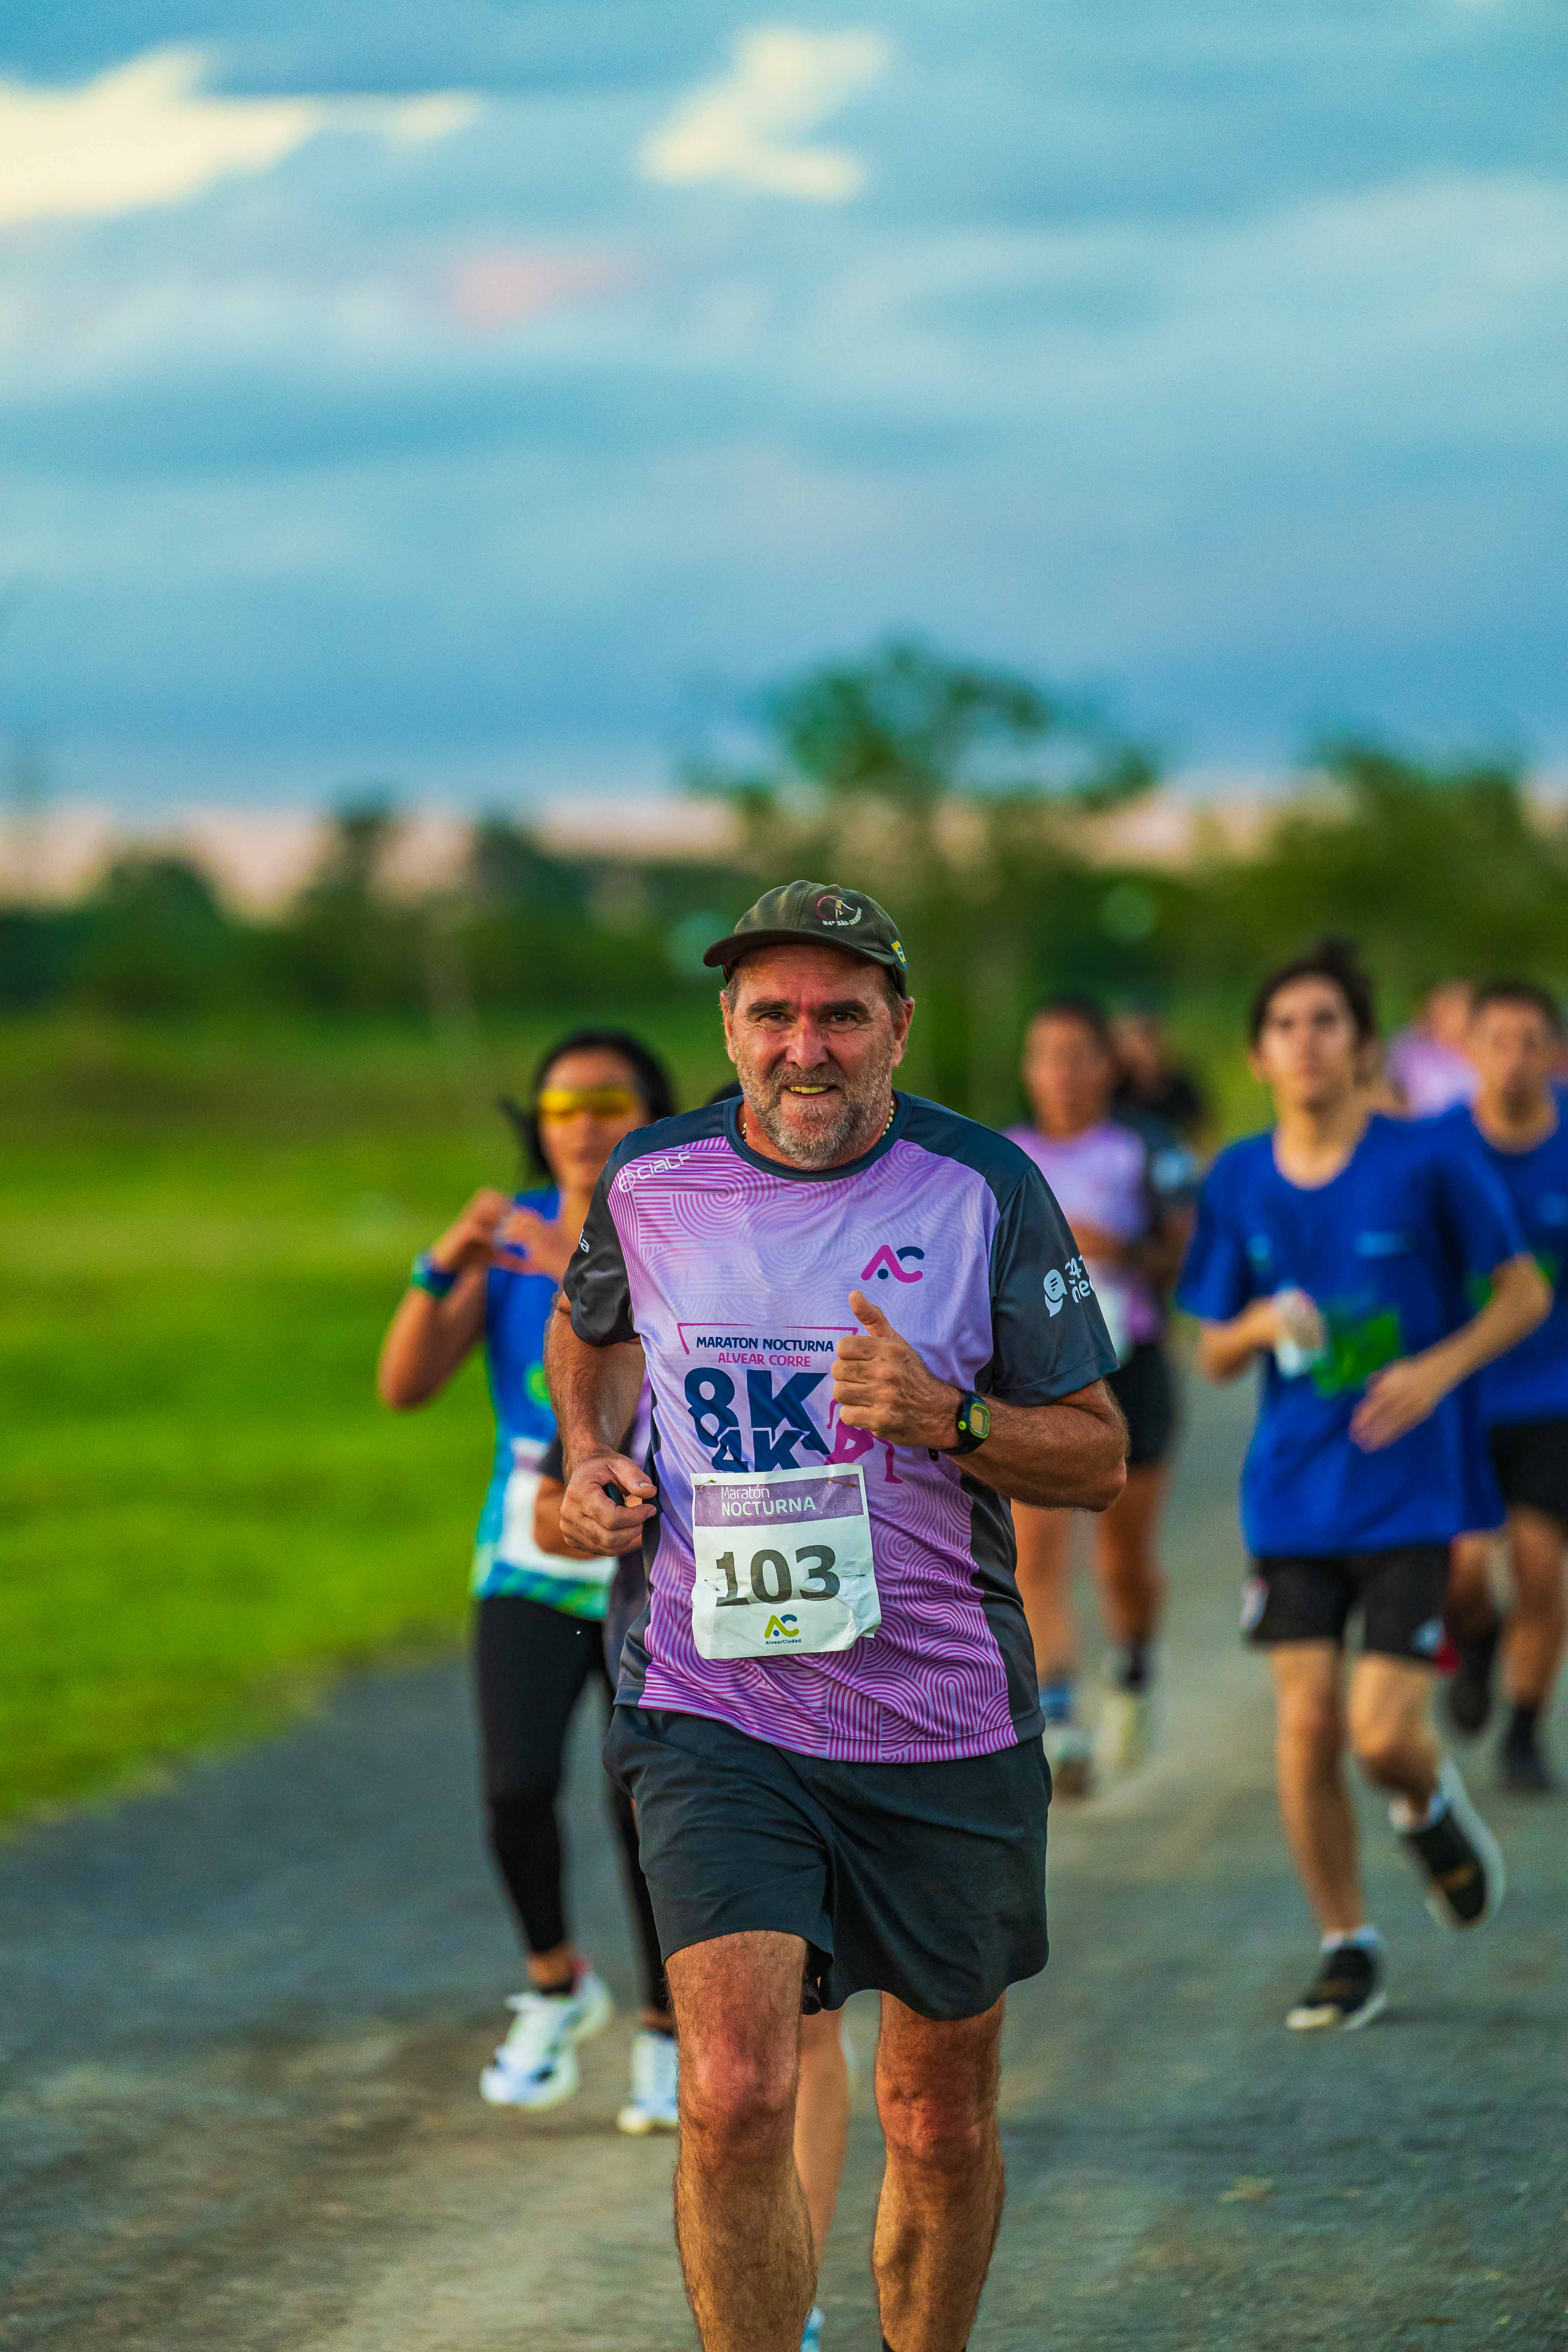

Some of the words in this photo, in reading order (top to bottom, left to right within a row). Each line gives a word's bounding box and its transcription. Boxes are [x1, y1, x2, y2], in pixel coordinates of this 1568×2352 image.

[861, 1244, 925, 1283] AC
[696, 1336, 758, 1349] MARATON
[763, 1339, 834, 1352] NOCTURNA
[718, 1352, 765, 1365] ALVEAR
[769, 1354, 811, 1367] CORRE
[684, 1367, 830, 1455] 8K
[711, 1430, 802, 1473] 4K
[721, 1484, 770, 1500] Maratón
[721, 1496, 817, 1517] NOCTURNA
[716, 1544, 841, 1607] 103
[764, 1614, 800, 1638] AC
